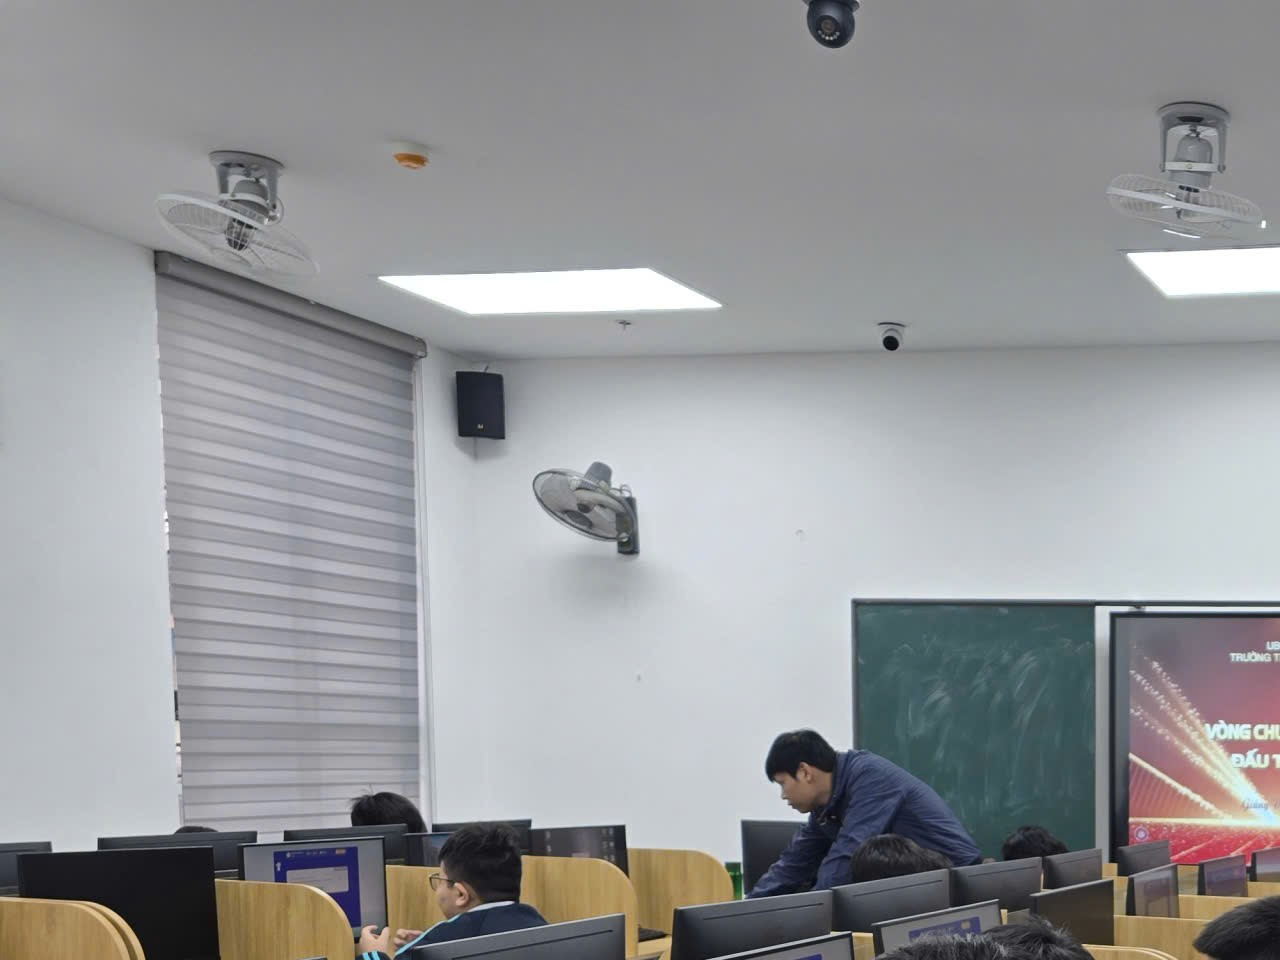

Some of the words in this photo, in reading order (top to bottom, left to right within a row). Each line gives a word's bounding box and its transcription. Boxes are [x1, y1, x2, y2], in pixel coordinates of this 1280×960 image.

[1229, 650, 1272, 663] TRƯỜNG
[1204, 719, 1251, 741] VÒNG
[1231, 748, 1270, 769] ĐẤU
